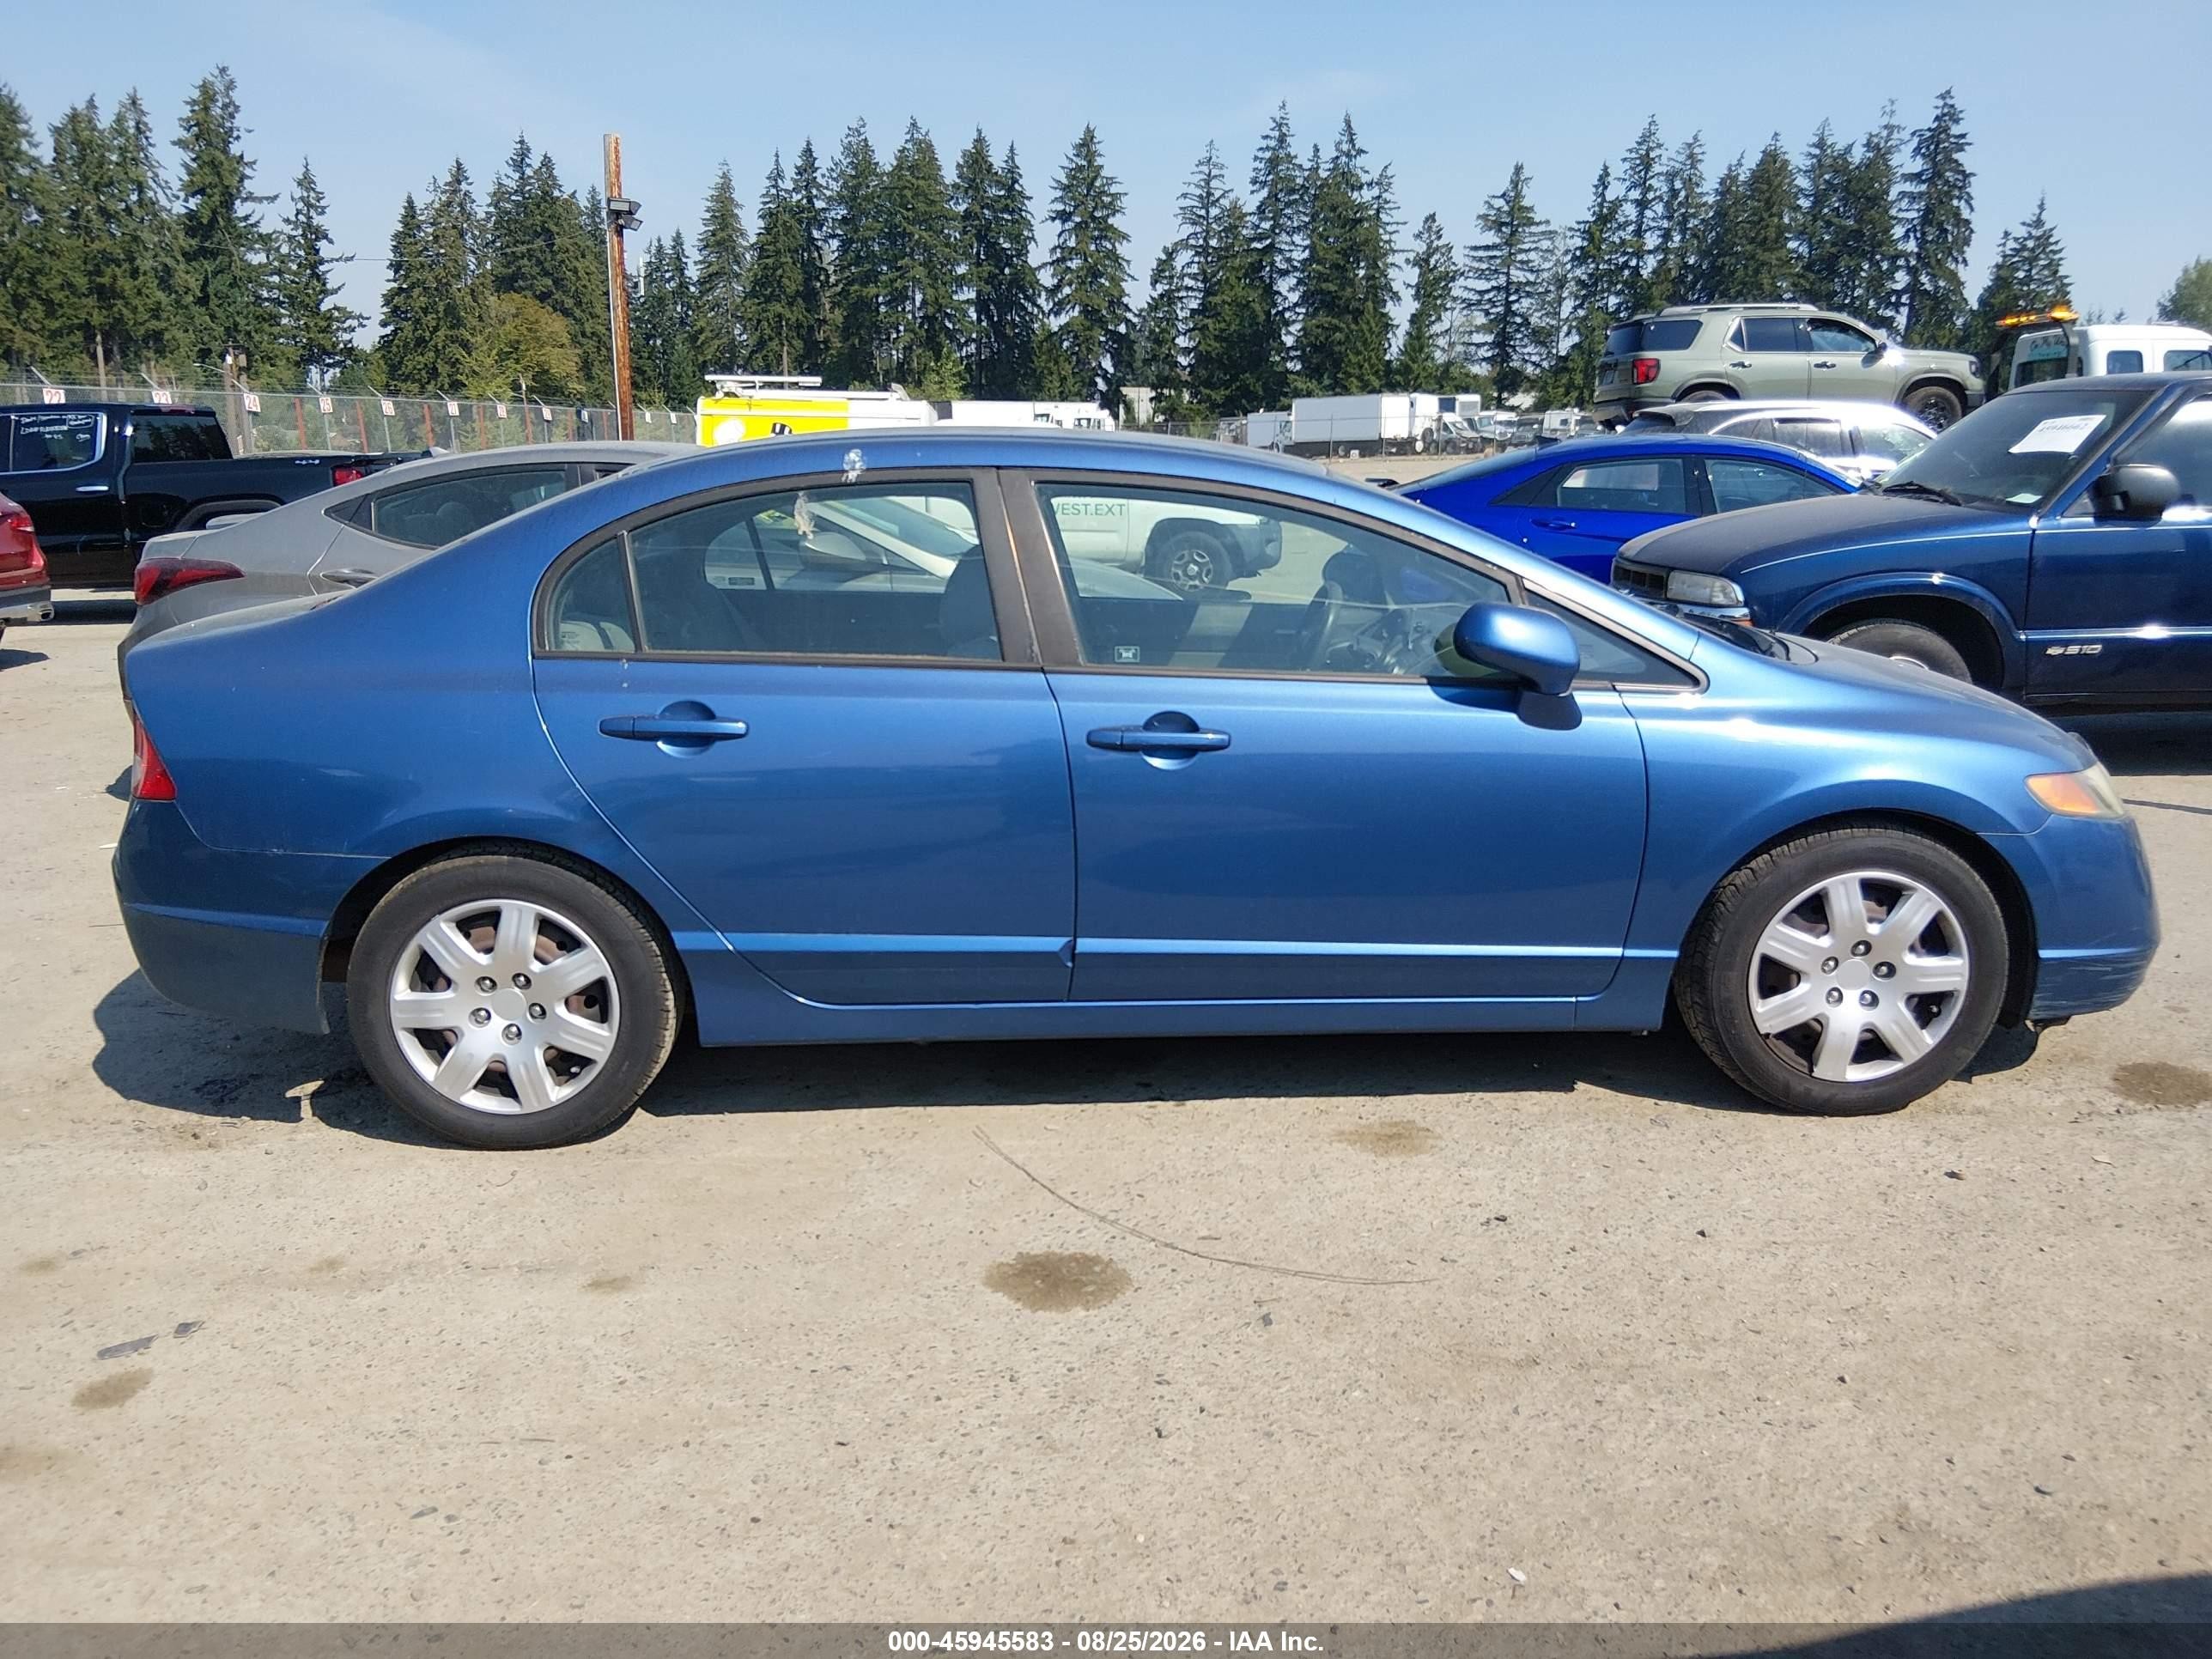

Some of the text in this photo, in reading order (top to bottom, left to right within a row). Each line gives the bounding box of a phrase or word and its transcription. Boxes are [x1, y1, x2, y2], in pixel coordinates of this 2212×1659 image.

[246, 394, 258, 410] 24
[321, 398, 331, 412] 25
[383, 402, 393, 415] 26
[2063, 644, 2102, 655] S10
